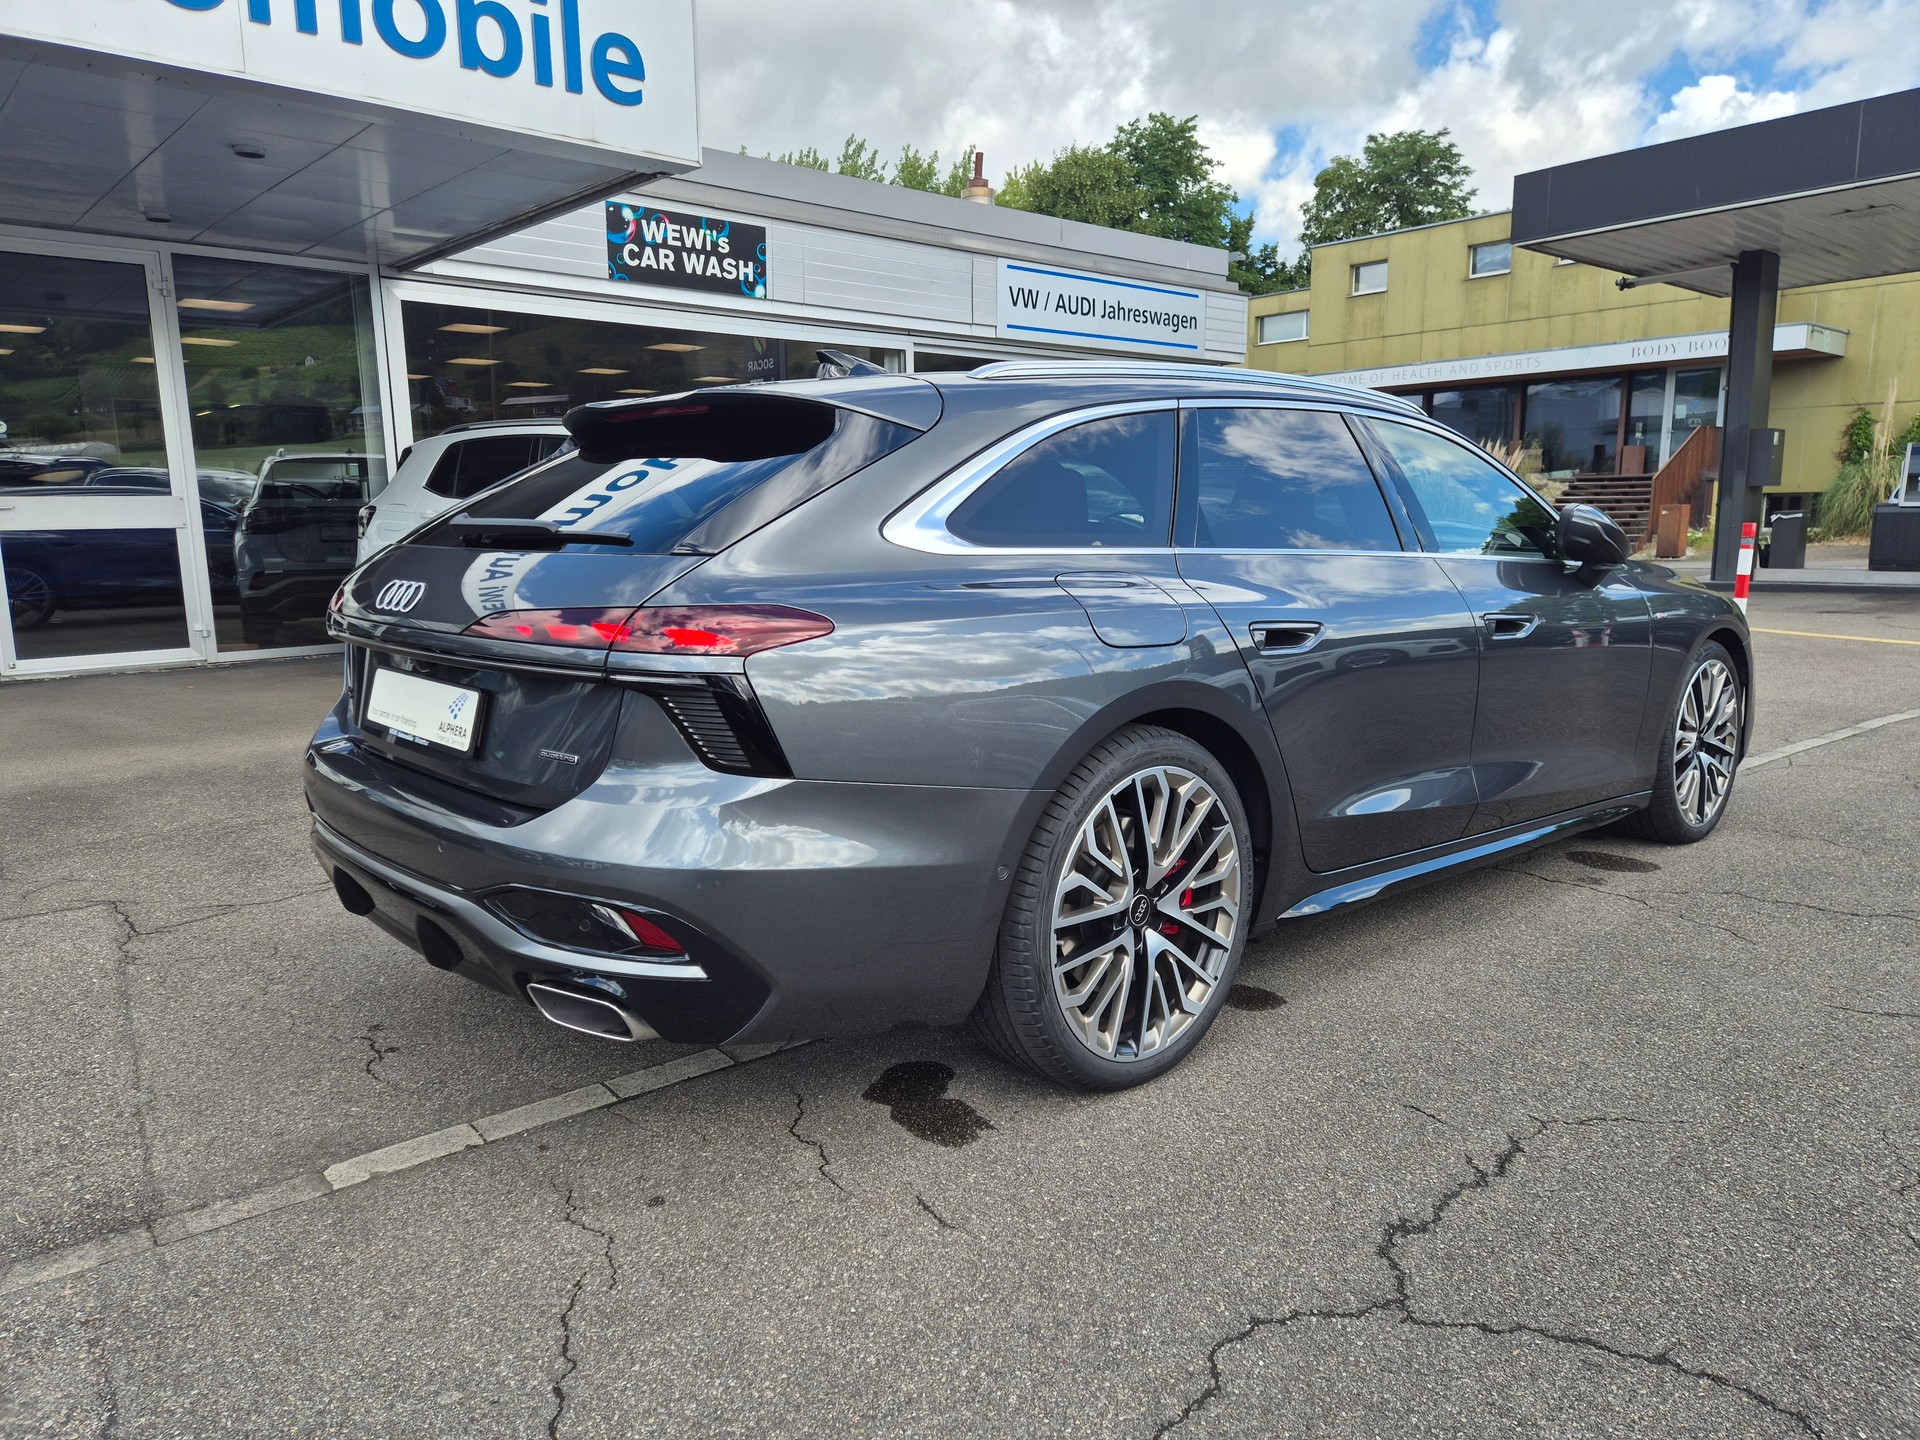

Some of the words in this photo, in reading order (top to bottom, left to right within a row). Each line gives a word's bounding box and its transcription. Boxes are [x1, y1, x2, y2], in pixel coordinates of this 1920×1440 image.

[160, 0, 646, 107] obile
[641, 219, 730, 254] WEWi's
[623, 243, 675, 272] CAR
[682, 251, 754, 282] WASH
[1009, 285, 1039, 310] VW
[1044, 291, 1051, 312] /
[1055, 293, 1096, 318] AUDI
[1100, 299, 1198, 333] Jahreswagen
[1631, 342, 1680, 359] BODY
[1369, 372, 1386, 384] OF
[1392, 366, 1442, 381] HEALTH
[1448, 362, 1479, 377] AND
[1485, 356, 1541, 373] SPORTS
[438, 721, 467, 739] ALPHERA
[540, 751, 575, 763] quattro
